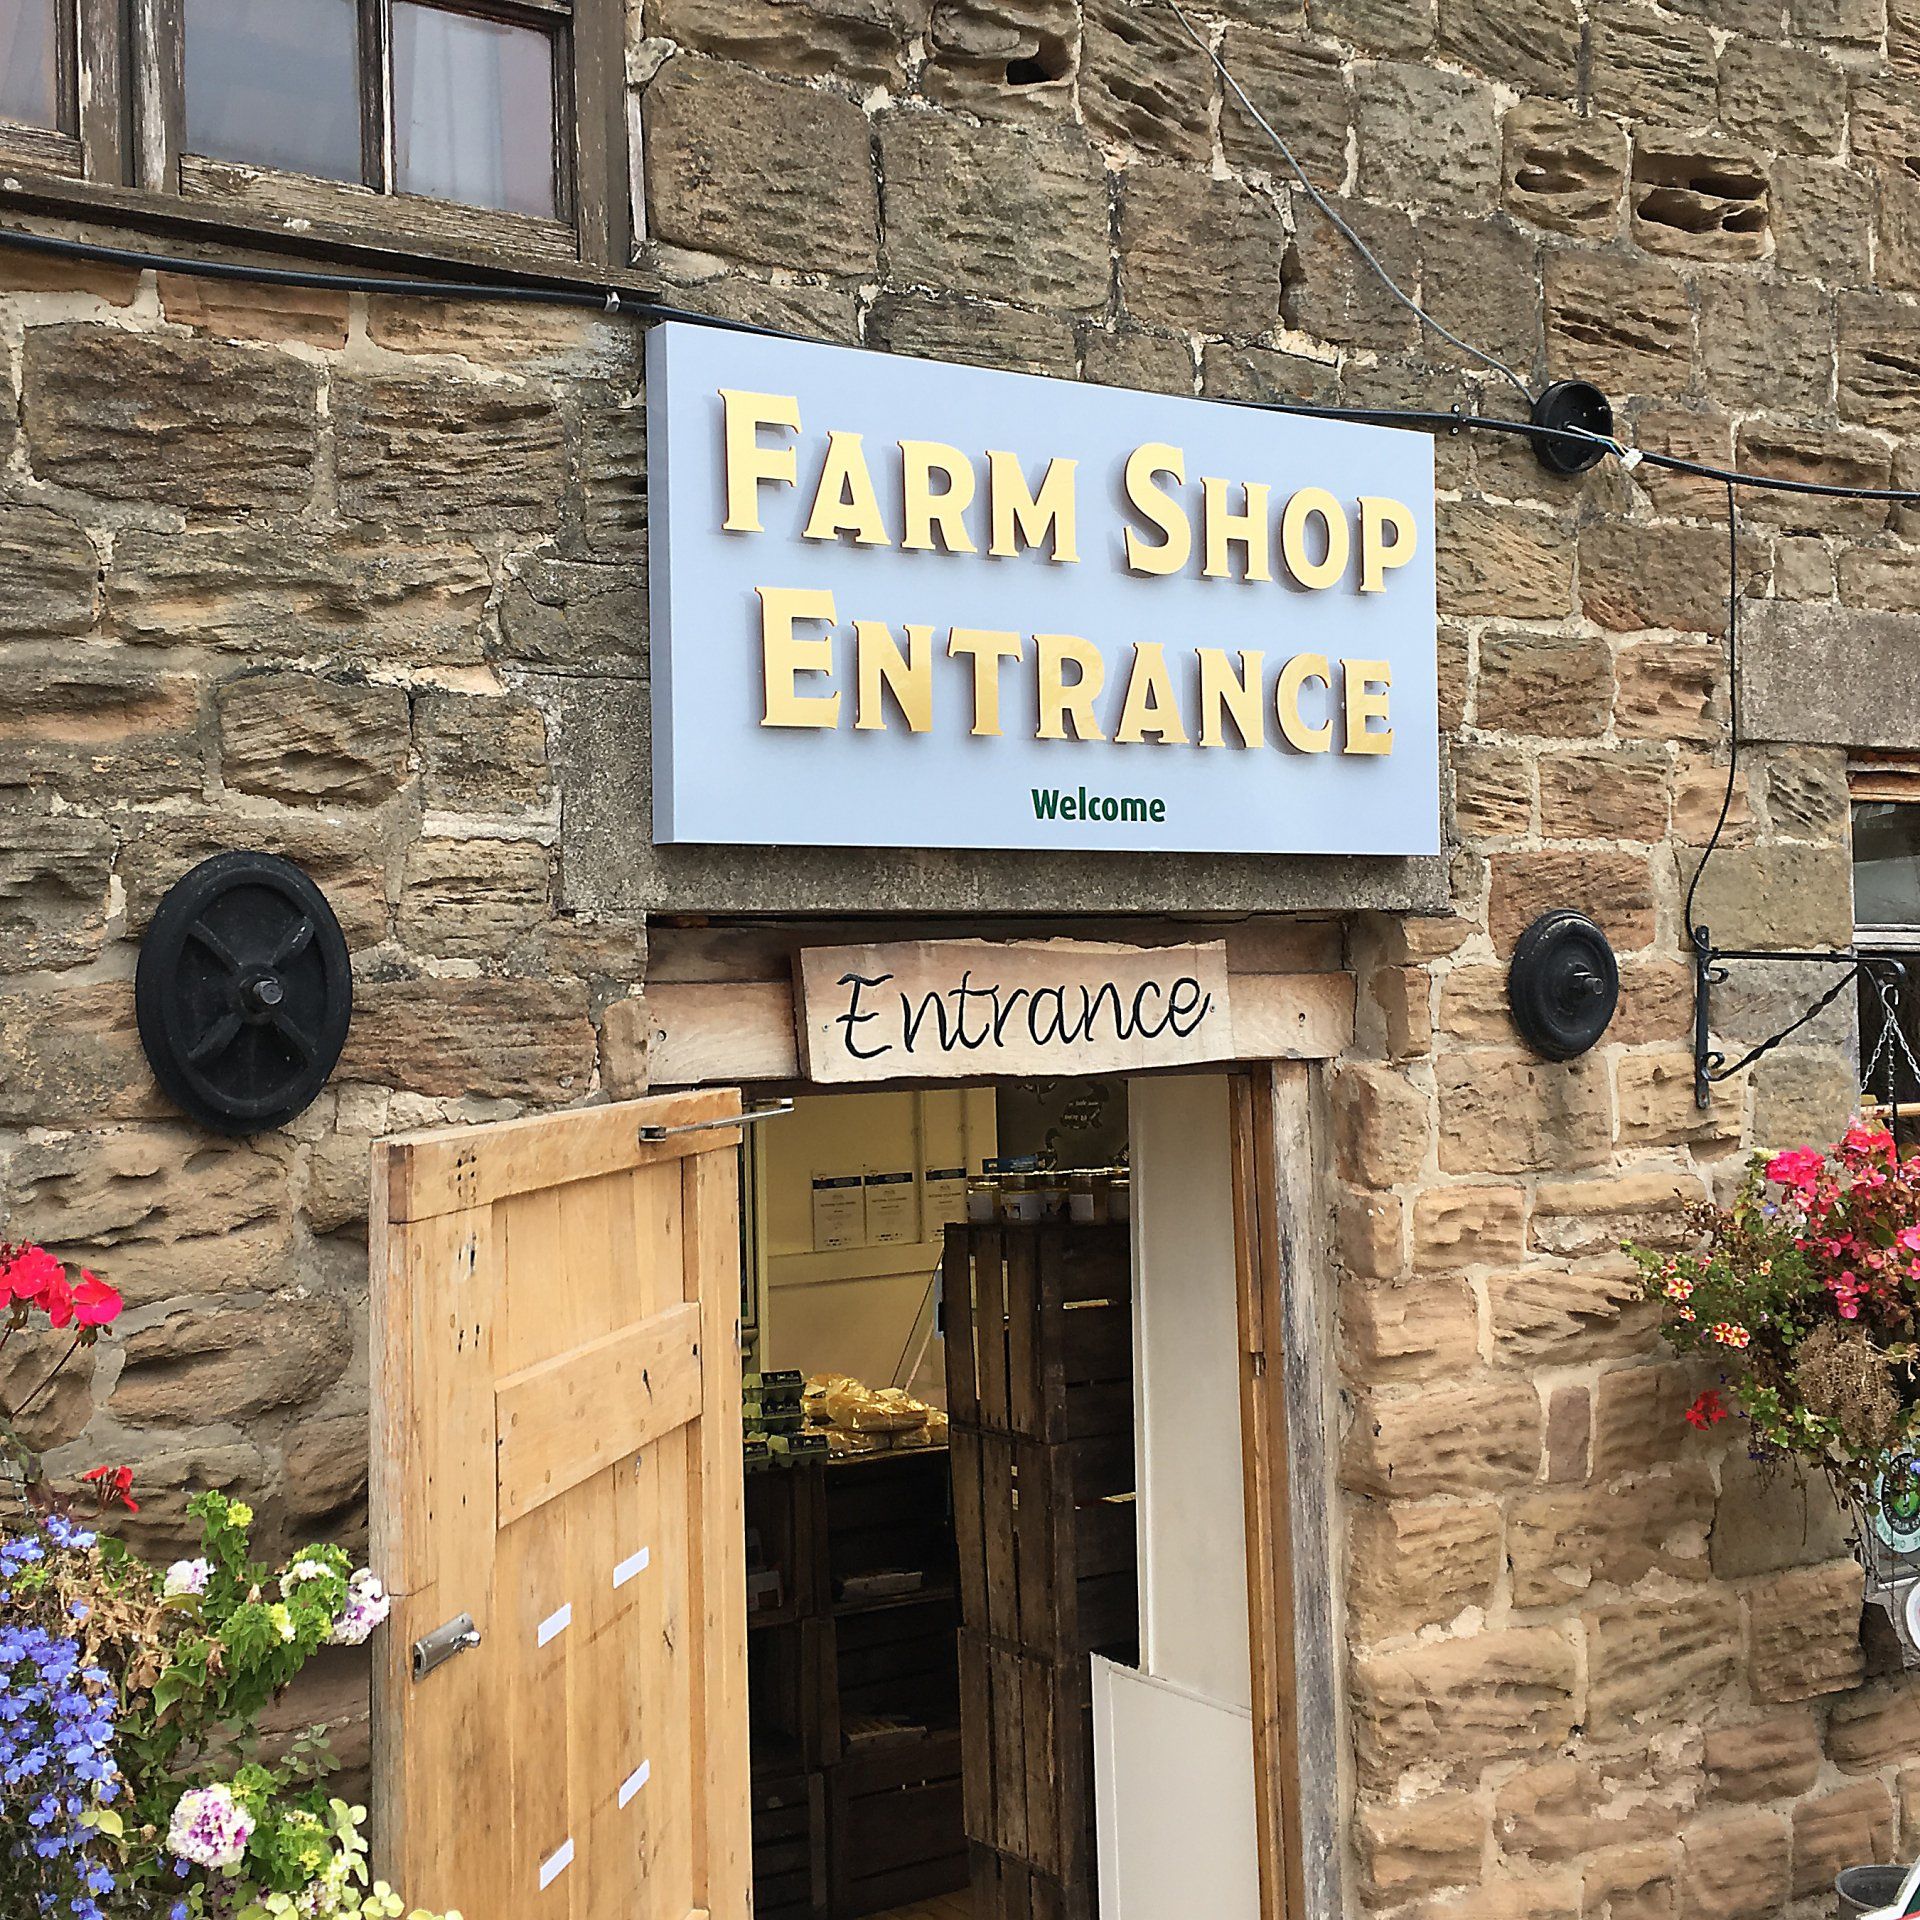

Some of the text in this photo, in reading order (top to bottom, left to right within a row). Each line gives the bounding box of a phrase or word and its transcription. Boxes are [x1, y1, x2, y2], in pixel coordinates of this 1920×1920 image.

[717, 388, 1418, 593] FARM SHOP
[754, 585, 1396, 756] ENTRANCE
[1031, 787, 1167, 822] Welcome
[835, 970, 1212, 1059] Entrance
